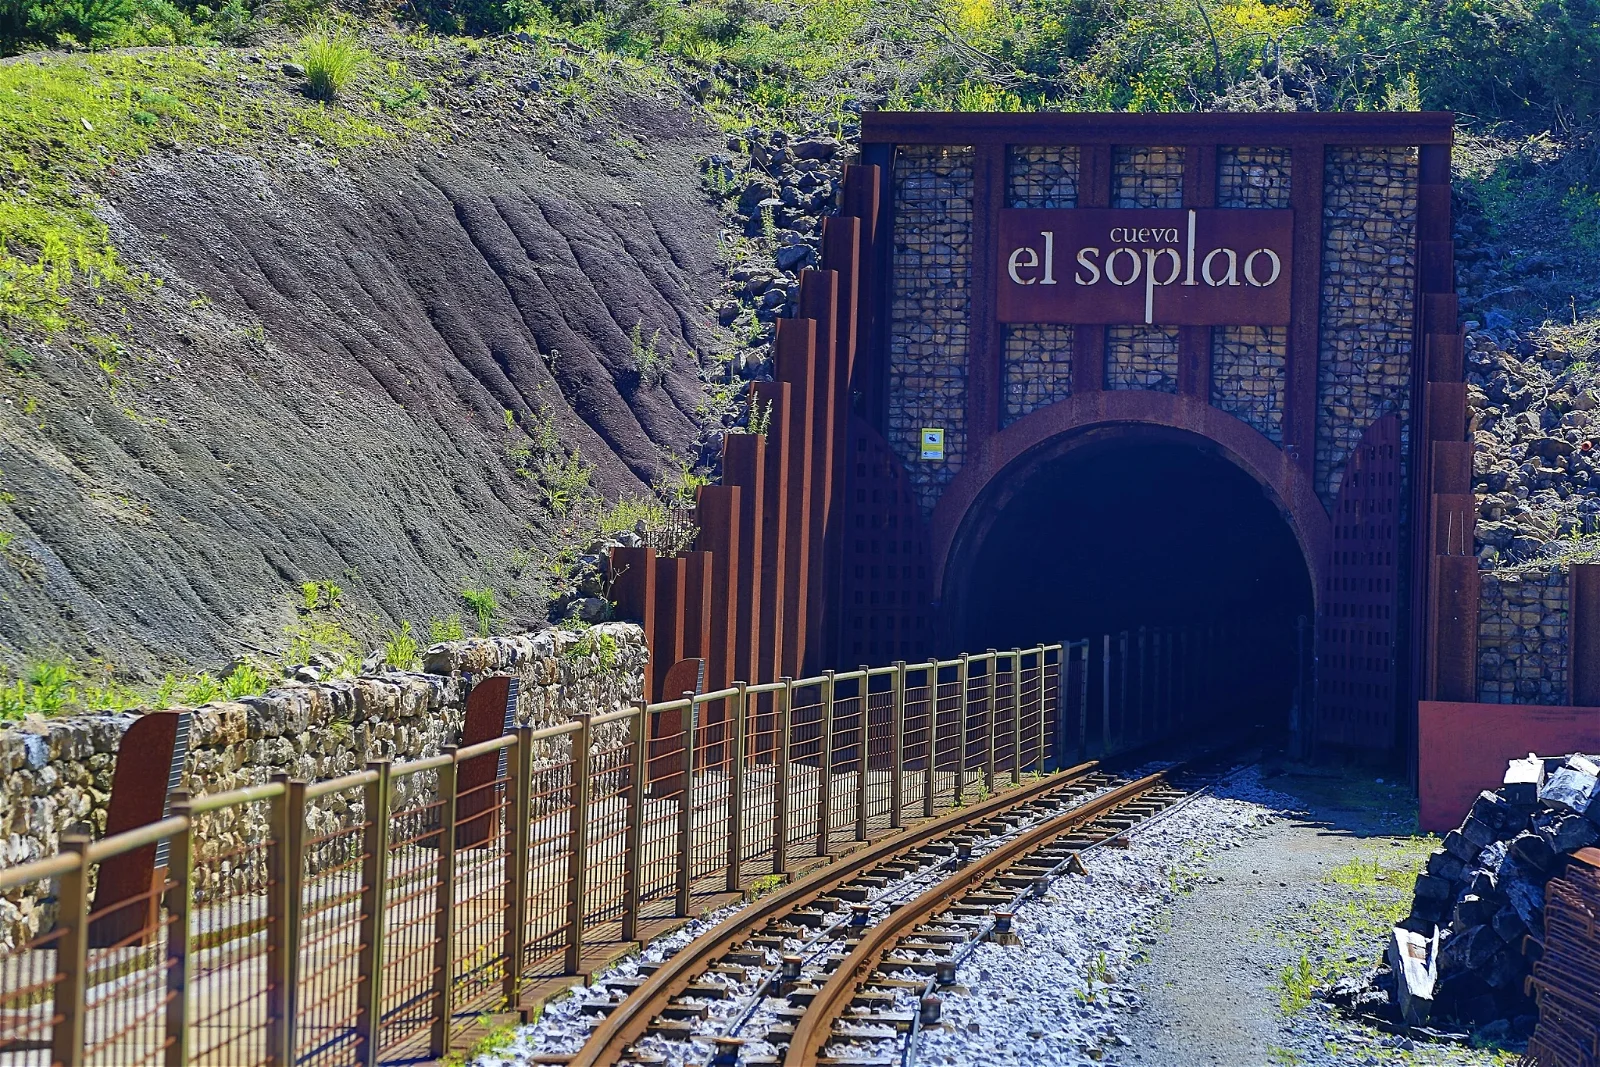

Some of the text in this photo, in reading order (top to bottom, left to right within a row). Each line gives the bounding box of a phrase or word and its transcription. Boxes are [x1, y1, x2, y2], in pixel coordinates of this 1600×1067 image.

[1007, 209, 1282, 324] el soplao
[1110, 226, 1179, 243] cueva
